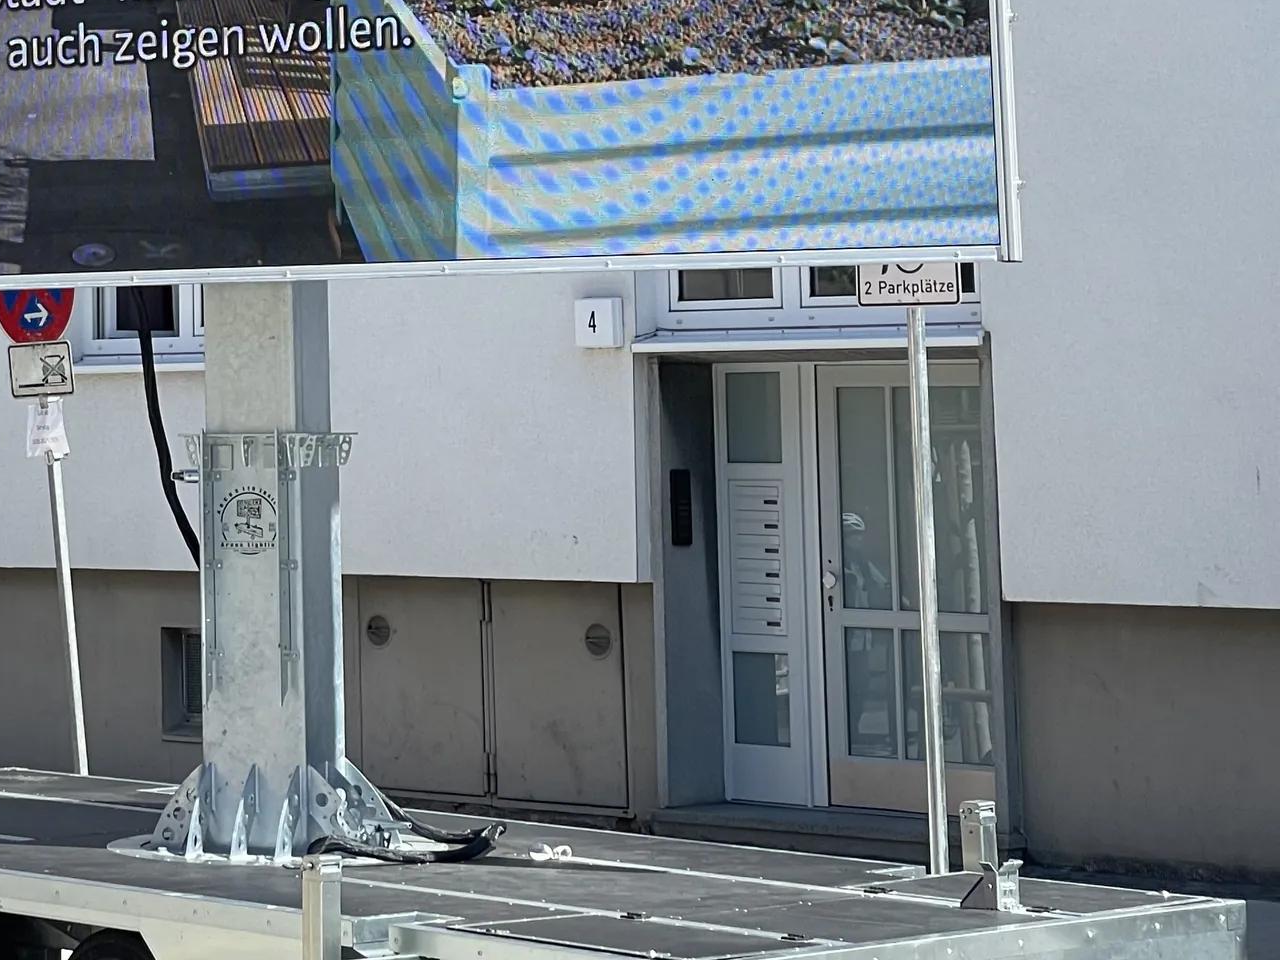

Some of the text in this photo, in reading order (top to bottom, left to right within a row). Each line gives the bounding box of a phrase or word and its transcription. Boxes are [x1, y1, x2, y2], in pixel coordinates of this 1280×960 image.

[8, 6, 412, 69] auch zeigen wollen.
[864, 279, 955, 297] 2 Parkplätze
[588, 310, 597, 334] 4
